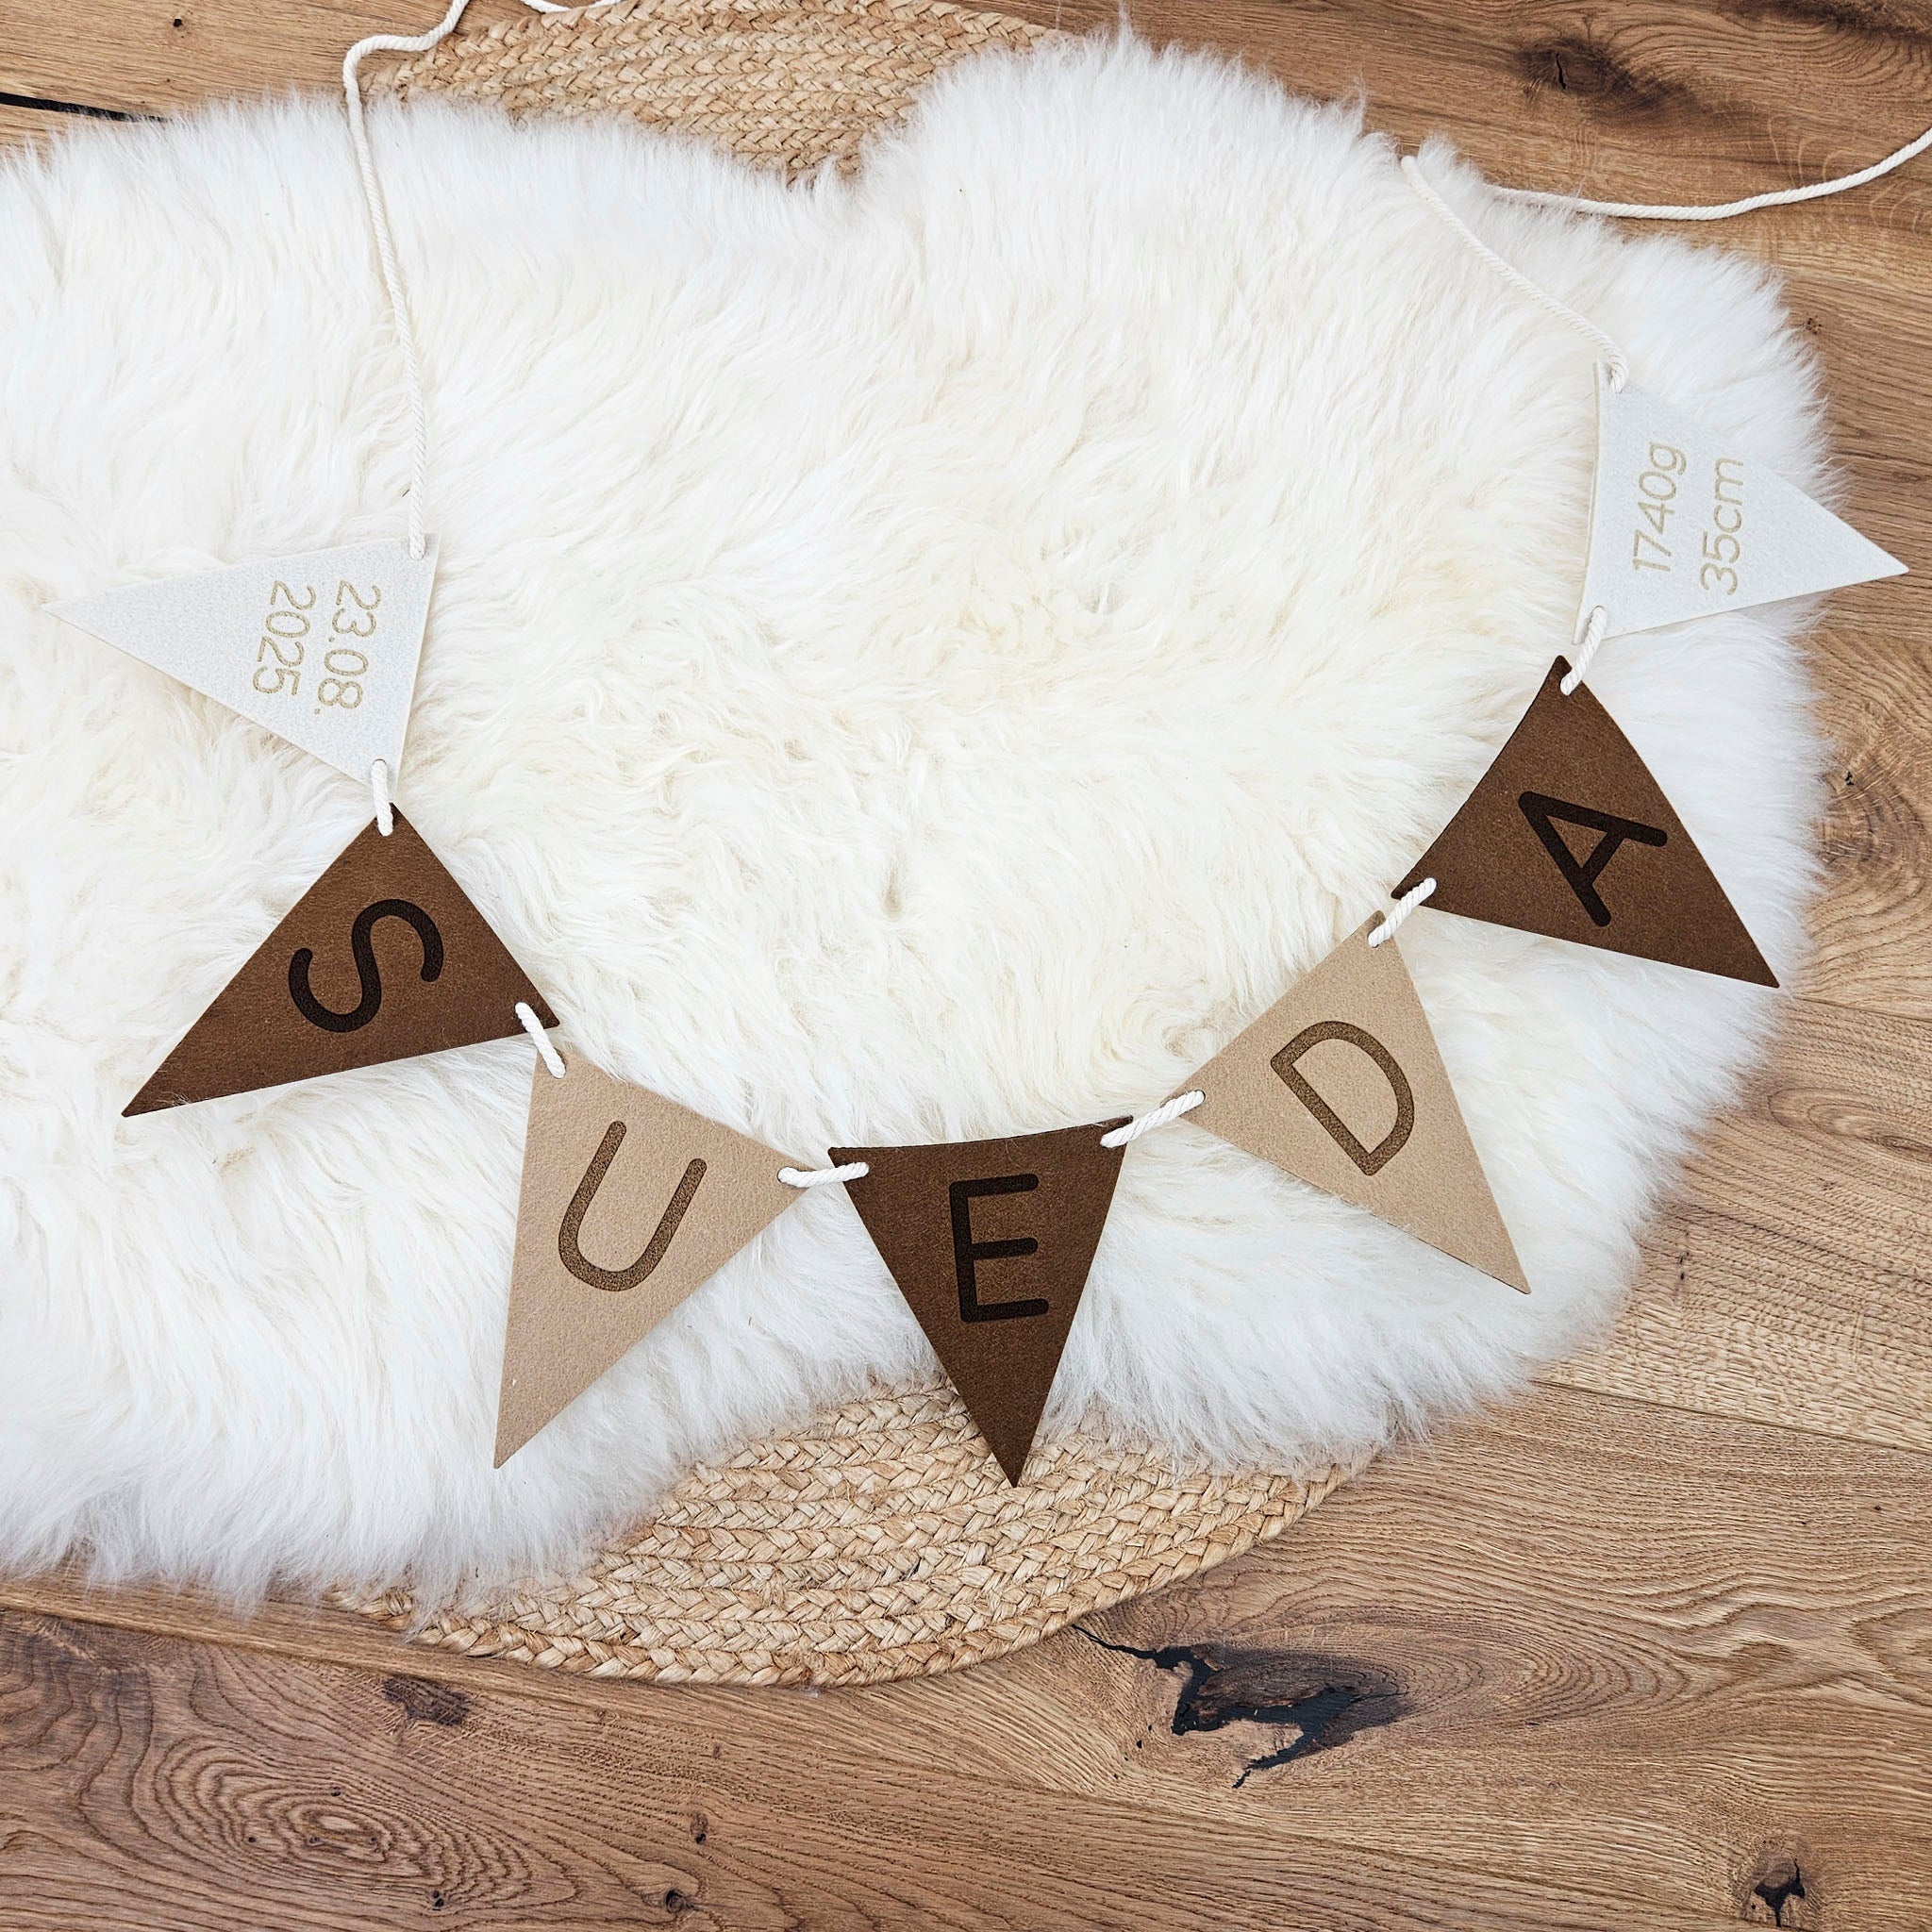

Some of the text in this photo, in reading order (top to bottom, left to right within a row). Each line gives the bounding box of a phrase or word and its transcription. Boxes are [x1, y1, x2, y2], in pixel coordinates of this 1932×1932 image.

[1632, 441, 1687, 572] 1740g
[1700, 458, 1744, 596] 35cm
[252, 579, 316, 694] 2025
[314, 579, 381, 715] 23.08.
[1518, 791, 1667, 926] A
[289, 900, 443, 1032] S
[1270, 1021, 1415, 1176] D
[558, 1121, 707, 1292] U
[949, 1174, 1049, 1324] E
